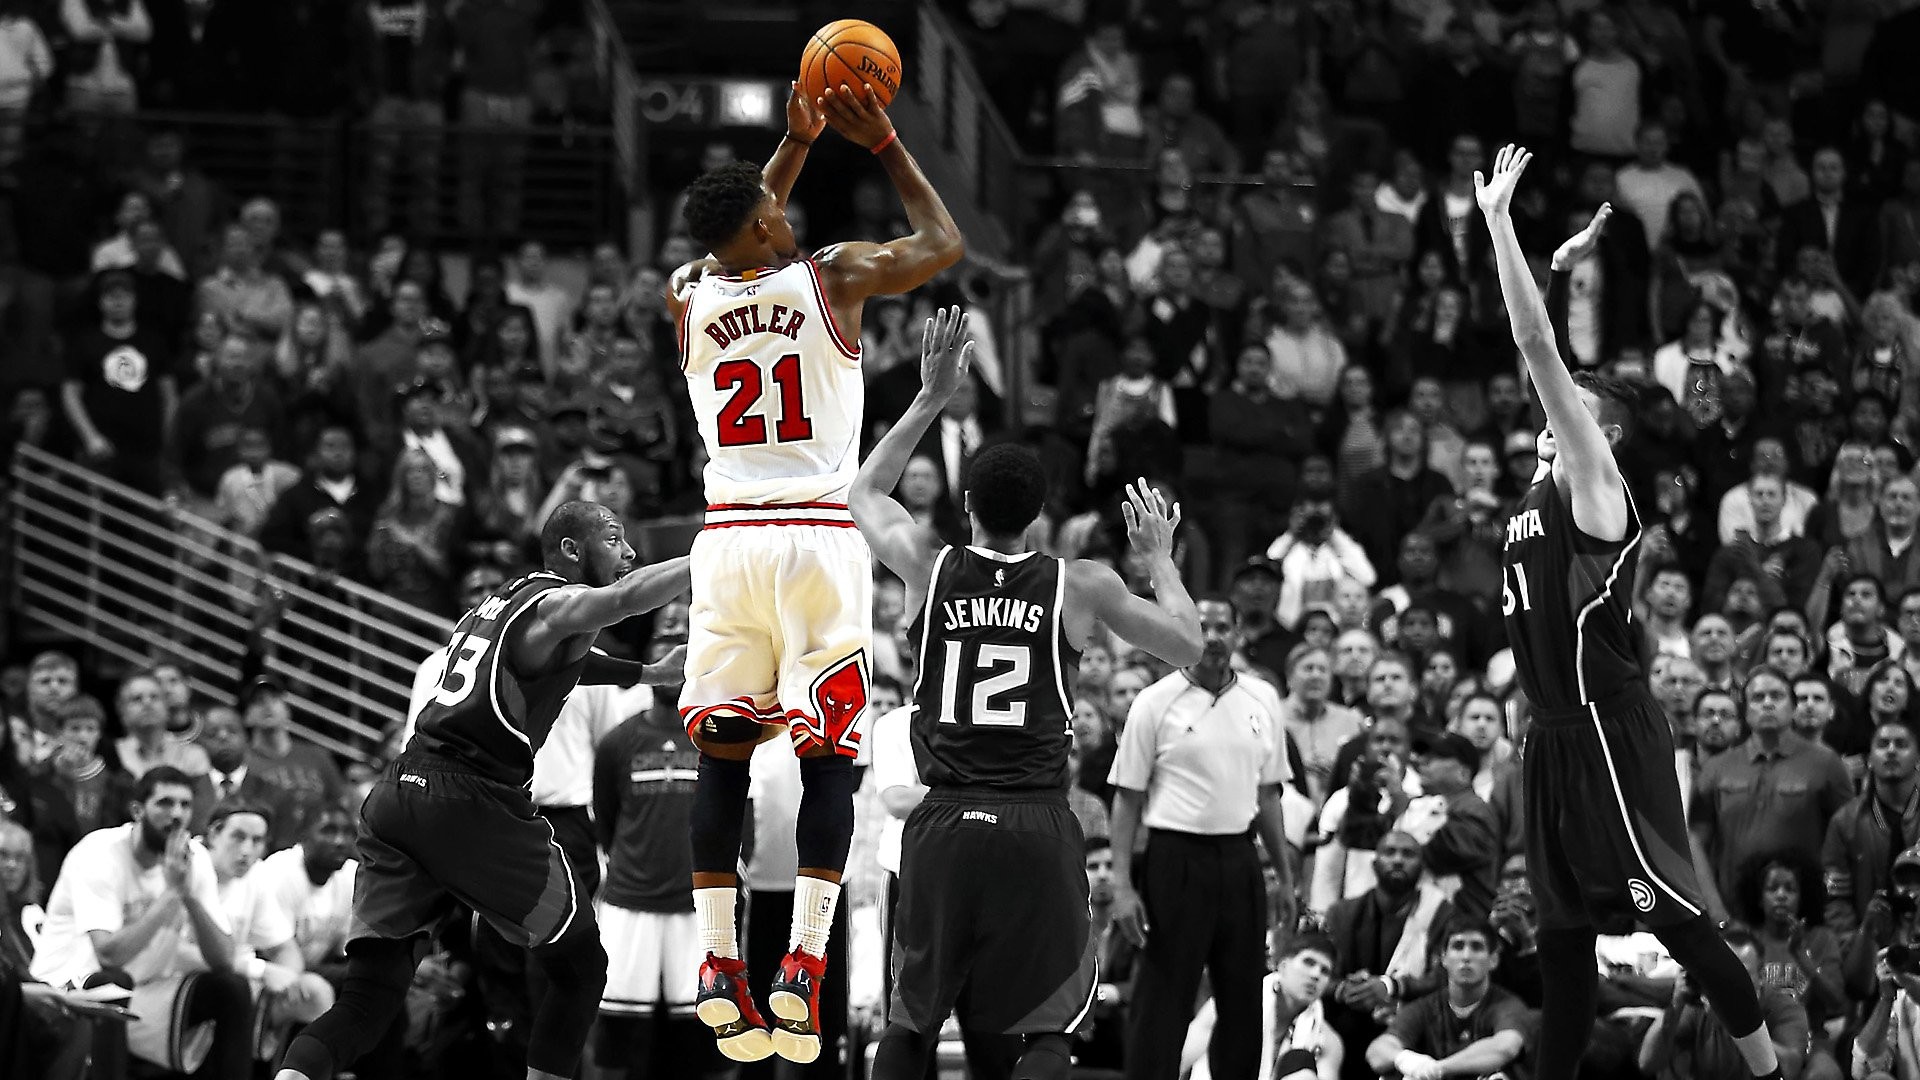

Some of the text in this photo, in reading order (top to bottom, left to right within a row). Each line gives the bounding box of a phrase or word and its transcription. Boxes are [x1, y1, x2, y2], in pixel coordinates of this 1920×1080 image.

[704, 304, 806, 350] BUTLER
[713, 353, 814, 447] 21
[1504, 509, 1545, 551] NTA
[942, 597, 1044, 633] JENKINS
[938, 640, 1031, 727] 12
[962, 811, 998, 824] HAWKS
